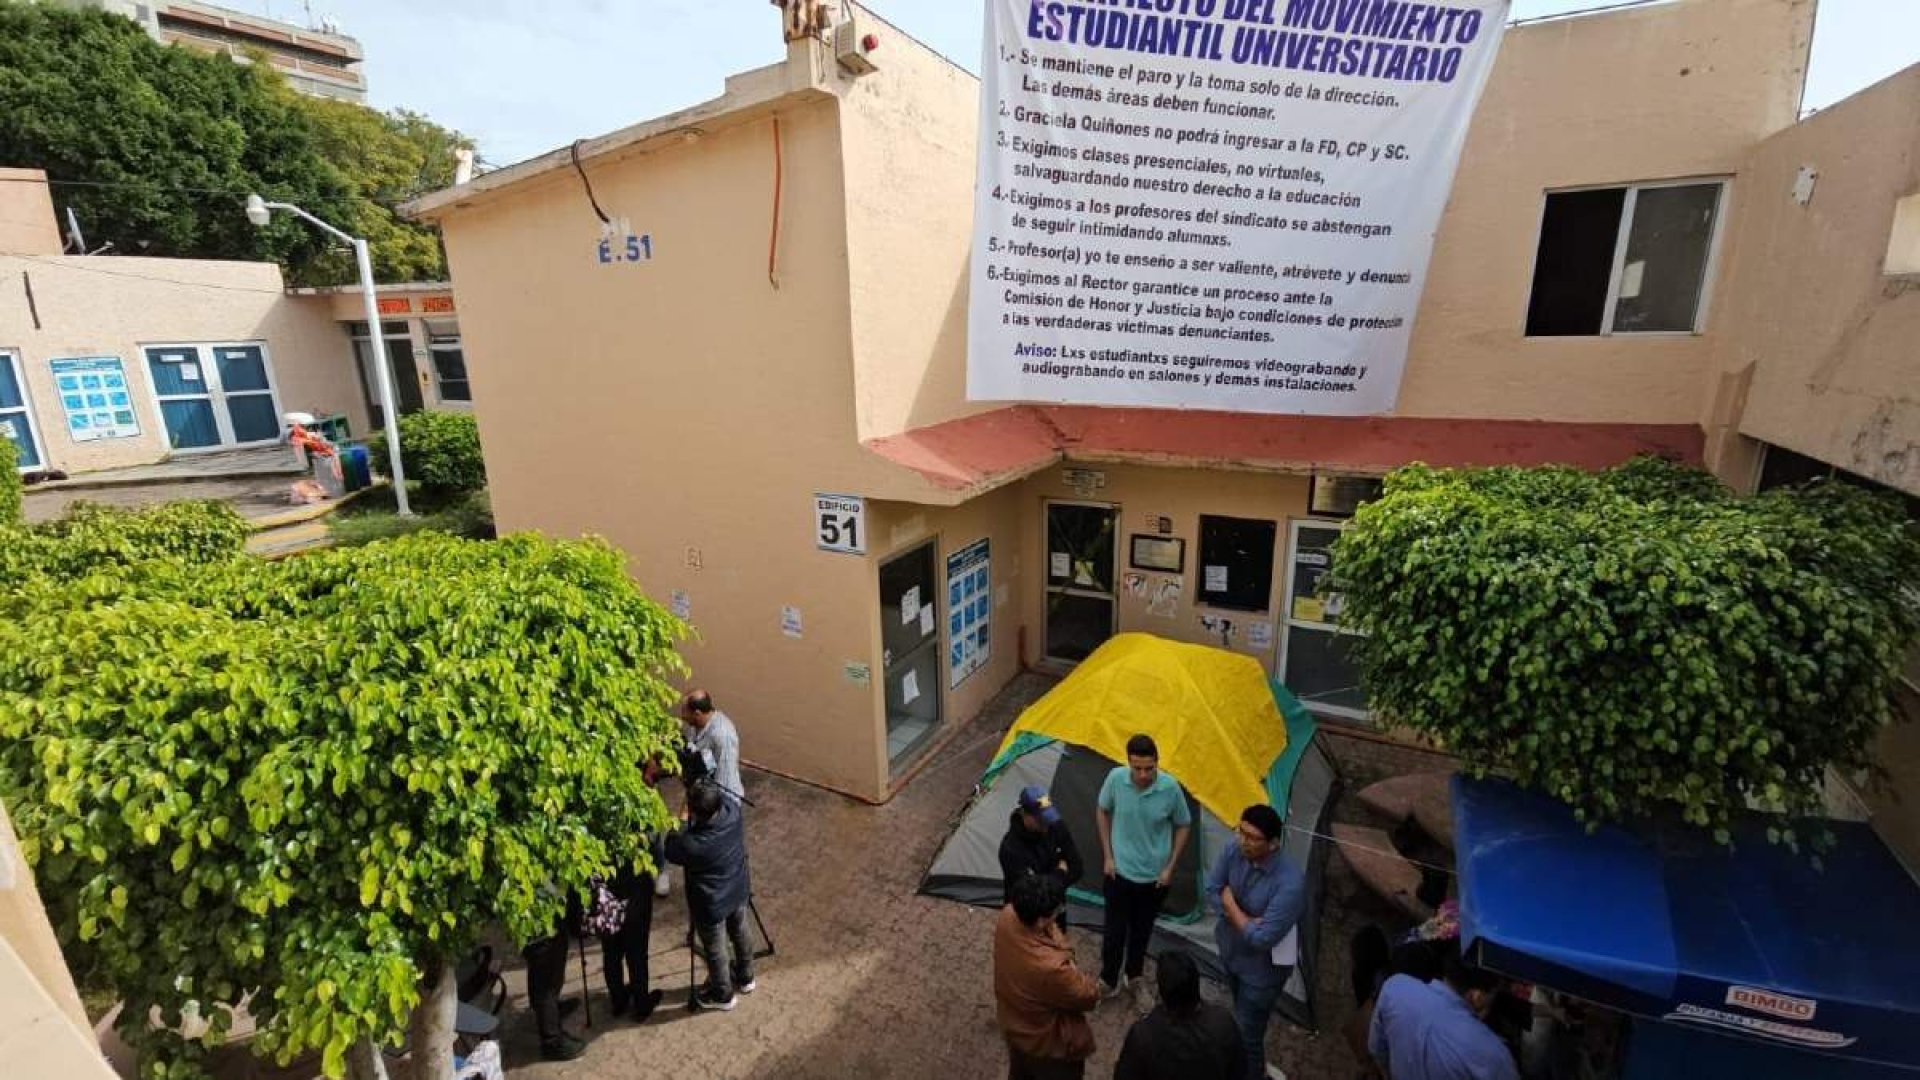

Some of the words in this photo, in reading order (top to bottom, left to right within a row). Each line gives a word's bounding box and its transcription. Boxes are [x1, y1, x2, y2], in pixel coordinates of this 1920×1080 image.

[1223, 0, 1274, 24] DEL
[1283, 0, 1483, 44] MOVIMIENTO
[1027, 2, 1225, 60] ESTUDIANTIL
[1231, 26, 1462, 83] UNIVERSITARIO
[1020, 48, 1037, 66] Se
[1042, 56, 1114, 78] mantiene
[1118, 63, 1133, 80] el
[1137, 69, 1172, 86] paro
[1175, 74, 1186, 89] y
[1188, 71, 1203, 88] la
[1207, 75, 1245, 93] toma
[1250, 80, 1280, 97] solo
[1284, 82, 1302, 99] de
[1306, 84, 1320, 100] la
[1324, 87, 1399, 108] dirección.
[1022, 74, 1047, 93] Las
[1052, 81, 1102, 102] demás
[1106, 87, 1149, 108] áreas
[1153, 93, 1199, 112] deben
[1203, 97, 1276, 121] funcionar.
[1014, 105, 1076, 129] Graciela
[1081, 116, 1150, 138] Quiñones
[1155, 127, 1173, 140] no
[1223, 130, 1284, 151] ingresar
[1288, 140, 1298, 151] a
[1301, 137, 1315, 153] la
[1317, 140, 1341, 159] FD,
[1346, 141, 1368, 158] CP
[1369, 146, 1382, 162] y
[1384, 143, 1410, 161] SC.
[1012, 136, 1078, 160] Exigimos
[1082, 147, 1130, 165] clases
[1133, 154, 1231, 177] presenciales,
[1236, 163, 1254, 176] no
[1258, 164, 1325, 185] virtuales,
[1014, 162, 1129, 188] salvaguardando
[1133, 176, 1189, 194] nuestro
[1193, 181, 1252, 200] derecho
[1255, 189, 1265, 200] a
[1268, 187, 1282, 202] la
[1286, 189, 1361, 208] educación
[1012, 212, 1027, 227] de
[1031, 217, 1076, 235] seguir
[1079, 220, 1163, 242] intimidando
[1076, 201, 1086, 212] a
[1089, 198, 1111, 214] los
[1114, 202, 1191, 222] profesores
[1196, 207, 1218, 224] del
[1222, 210, 1287, 230] sindicato
[1291, 218, 1308, 231] se
[1312, 218, 1392, 239] abstengan
[1085, 251, 1101, 265] yo
[1106, 251, 1119, 264] te
[1178, 259, 1188, 270] a
[1192, 259, 1215, 272] ser
[1218, 260, 1278, 279] valiente,
[1345, 270, 1356, 285] y
[1065, 273, 1077, 287] al
[1081, 274, 1129, 291] Rector
[1132, 280, 1199, 298] garantice
[1203, 286, 1220, 299] un
[1223, 288, 1279, 304] proceso
[1283, 292, 1316, 305] ante
[1320, 292, 1333, 306] la
[1003, 313, 1009, 324] a
[1012, 312, 1030, 326] las
[1034, 316, 1112, 332] verdaderas
[1178, 324, 1275, 343] denunciantes.
[1067, 294, 1085, 309] de
[1089, 296, 1131, 312] Honor
[1133, 302, 1143, 316] y
[1147, 301, 1201, 318] Justicia
[1205, 304, 1234, 323] bajo
[1238, 309, 1322, 326] condiciones
[1327, 313, 1345, 327] de
[1014, 342, 1057, 358] Aviso:
[1061, 345, 1085, 360] Lxs
[1089, 348, 1168, 366] estudiantxs
[1172, 354, 1250, 371] seguiremos
[1254, 358, 1356, 377] videograbando
[1358, 364, 1368, 379] y
[1022, 361, 1124, 380] audiograbando
[1128, 368, 1145, 380] en
[1149, 369, 1201, 383] salones
[1203, 372, 1212, 386] y
[1263, 375, 1357, 393] instalaciones.
[819, 500, 860, 512] EDIFICIO
[821, 514, 857, 547] 51
[1734, 990, 1810, 1016] BIMBO
